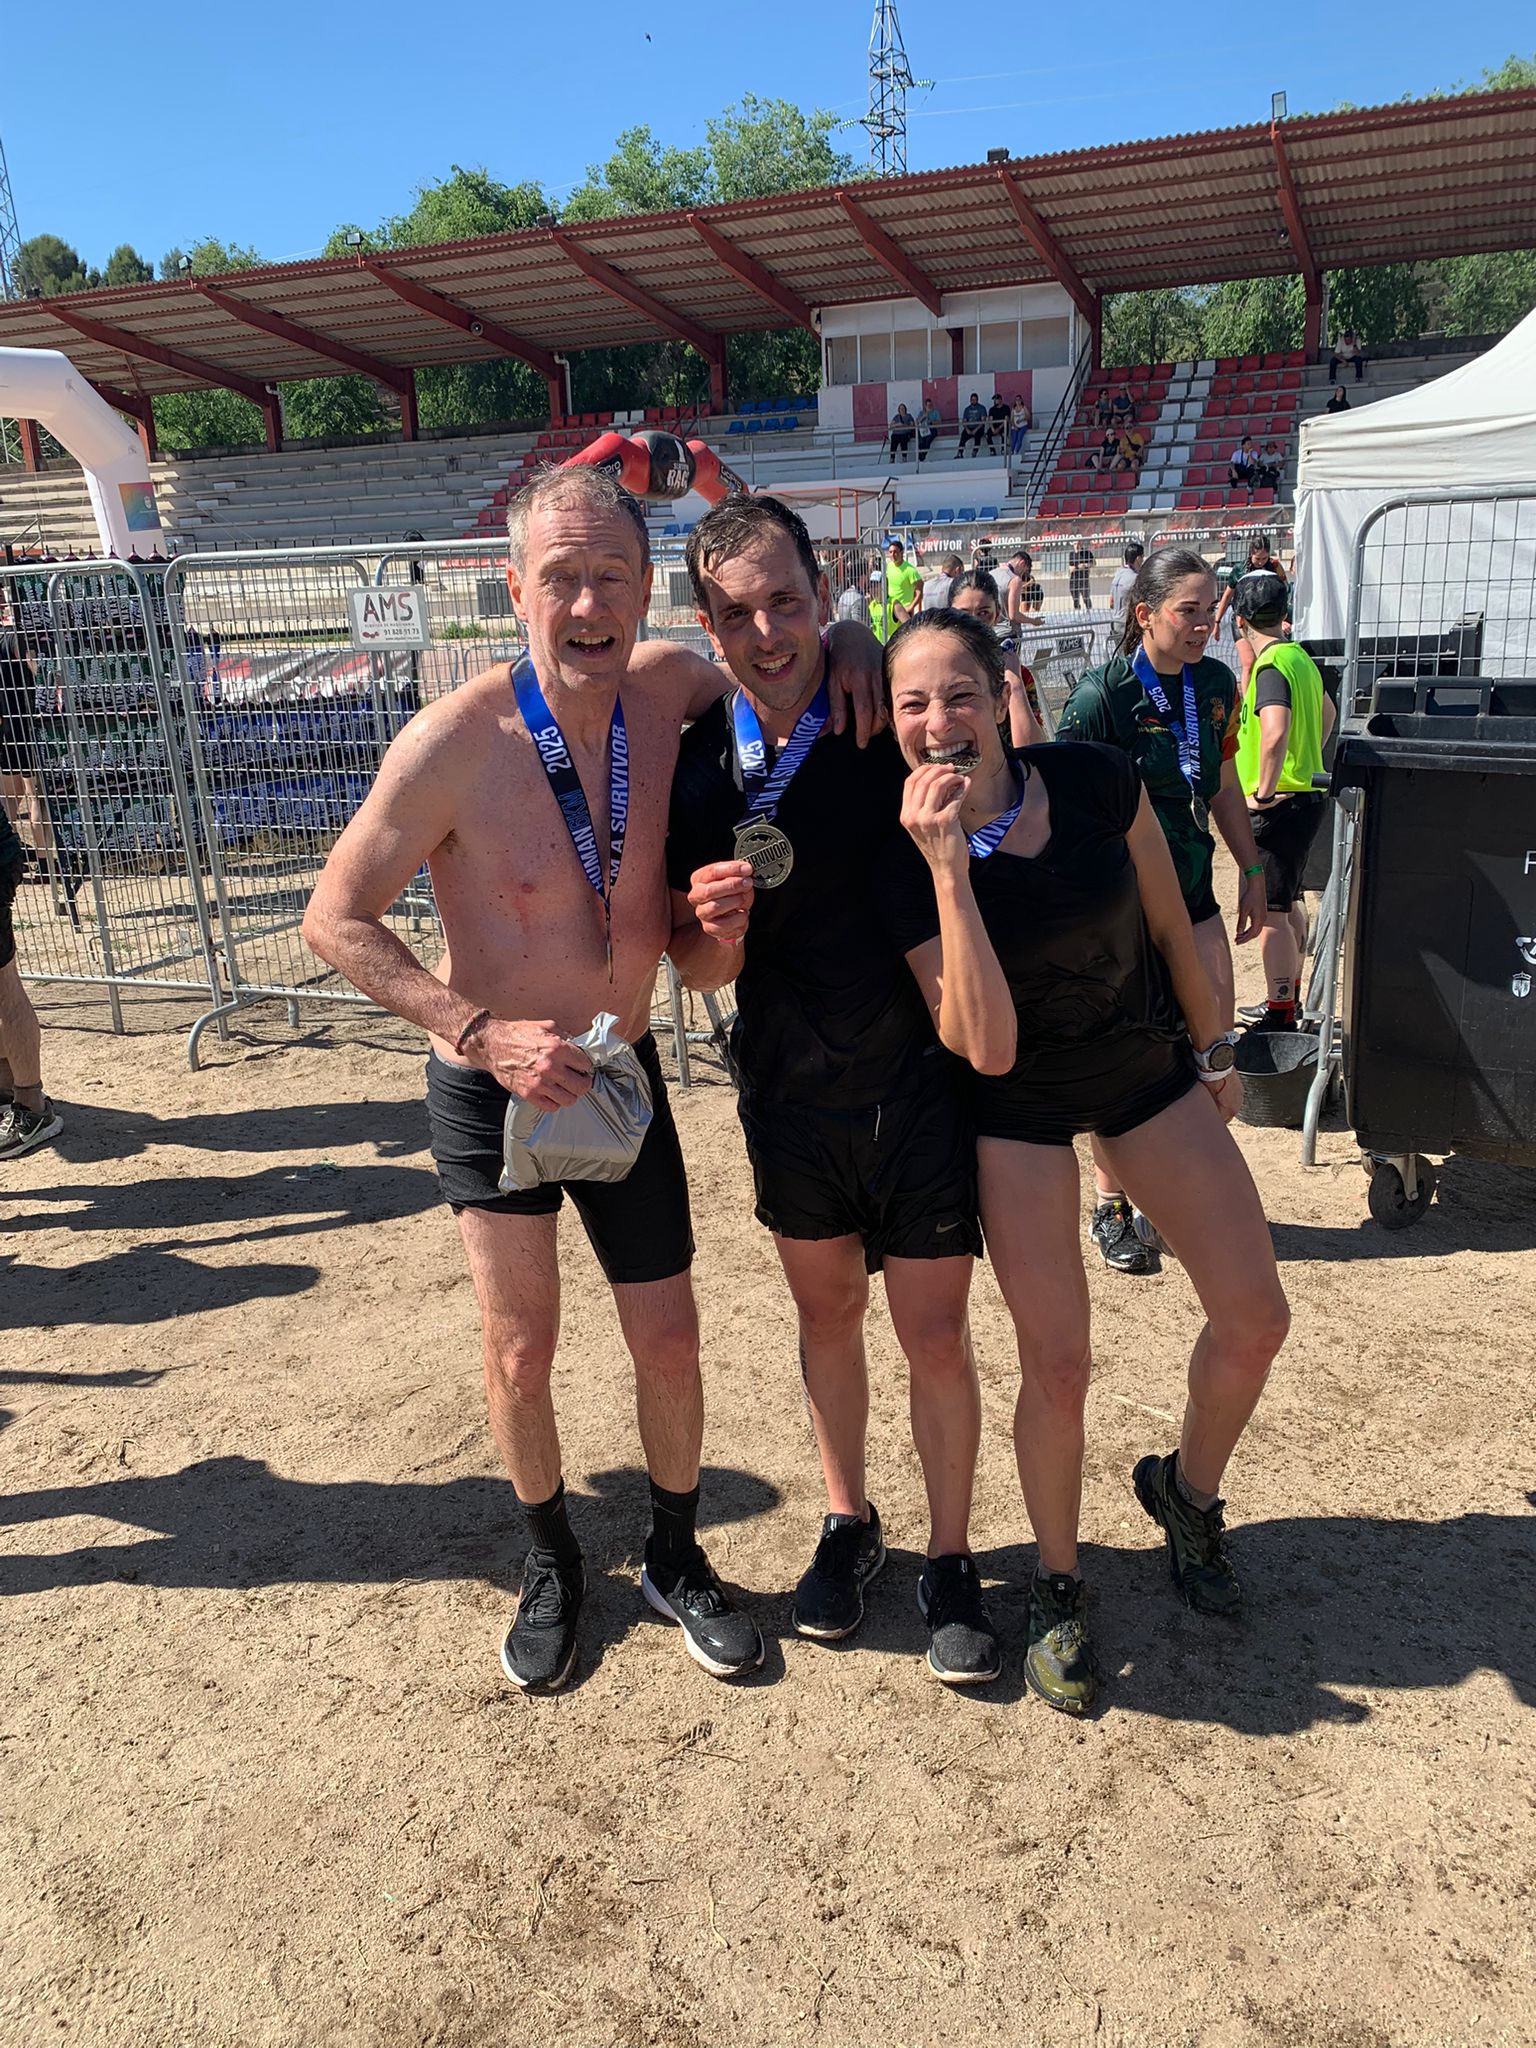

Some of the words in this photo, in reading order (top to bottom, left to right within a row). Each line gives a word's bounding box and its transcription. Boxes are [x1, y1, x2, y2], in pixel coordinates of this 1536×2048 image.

[915, 539, 962, 553] SURVIVOR
[970, 536, 1022, 549] SVIVOR
[364, 593, 413, 622] AMS
[1148, 686, 1172, 713] 2025
[1183, 685, 1200, 747] SURVIVOR
[533, 725, 572, 774] 2025
[740, 740, 768, 779] 2025
[770, 711, 826, 779] SURVIVOR
[611, 724, 629, 833] SURVIVOR
[764, 778, 792, 788] A
[750, 790, 784, 810] I'M
[572, 825, 605, 890] HUMAN
[610, 839, 624, 853] A
[742, 840, 790, 869] RVIVOR
